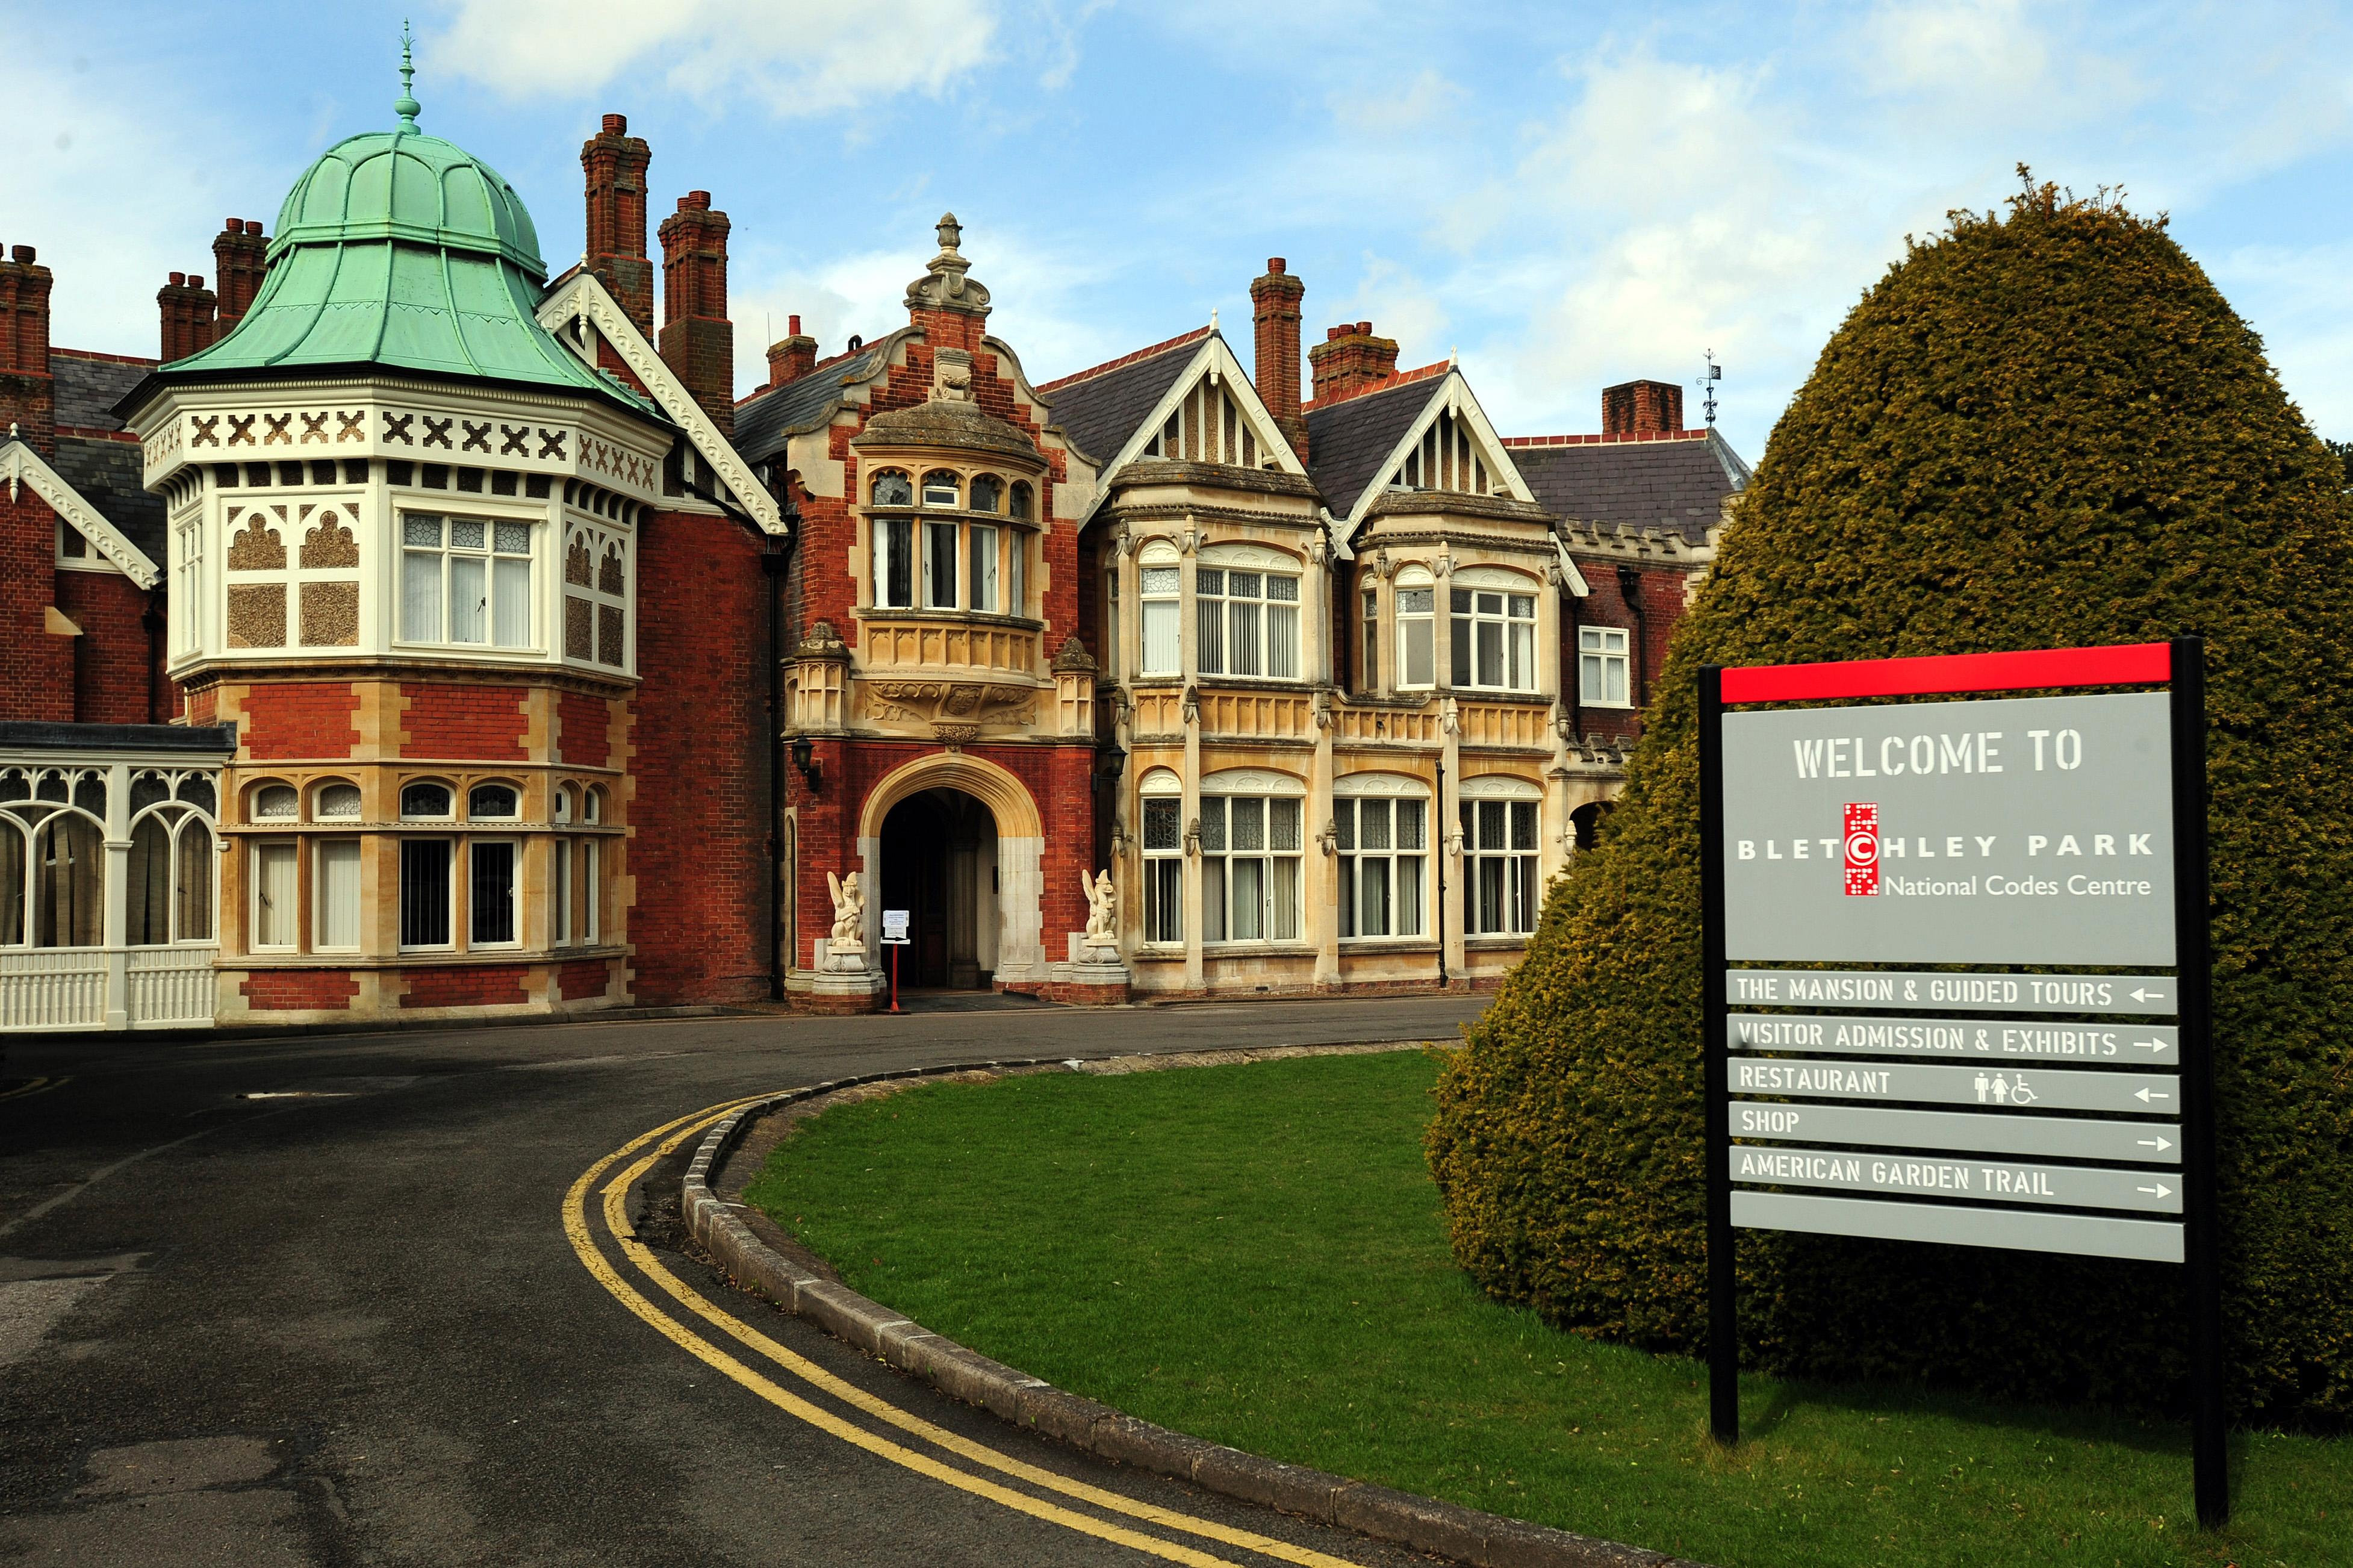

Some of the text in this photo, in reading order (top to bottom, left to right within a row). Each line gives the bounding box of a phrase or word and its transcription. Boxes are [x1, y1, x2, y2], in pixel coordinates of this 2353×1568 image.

[1793, 729, 2081, 779] WELCOME TO
[1738, 832, 2153, 866] BLETCHLEY PARK
[1885, 874, 2151, 895] National Codes Centre
[1736, 978, 2112, 1006] THE MANSION & GUIDED TOURS
[1738, 1022, 2116, 1056] VISITOR ADMISSION & EXHIBITS
[1740, 1066, 1890, 1094] RESTAURANT
[1742, 1110, 1799, 1133] SHOP
[1741, 1154, 2054, 1196] AMERICAN GARDEN TRAIL
